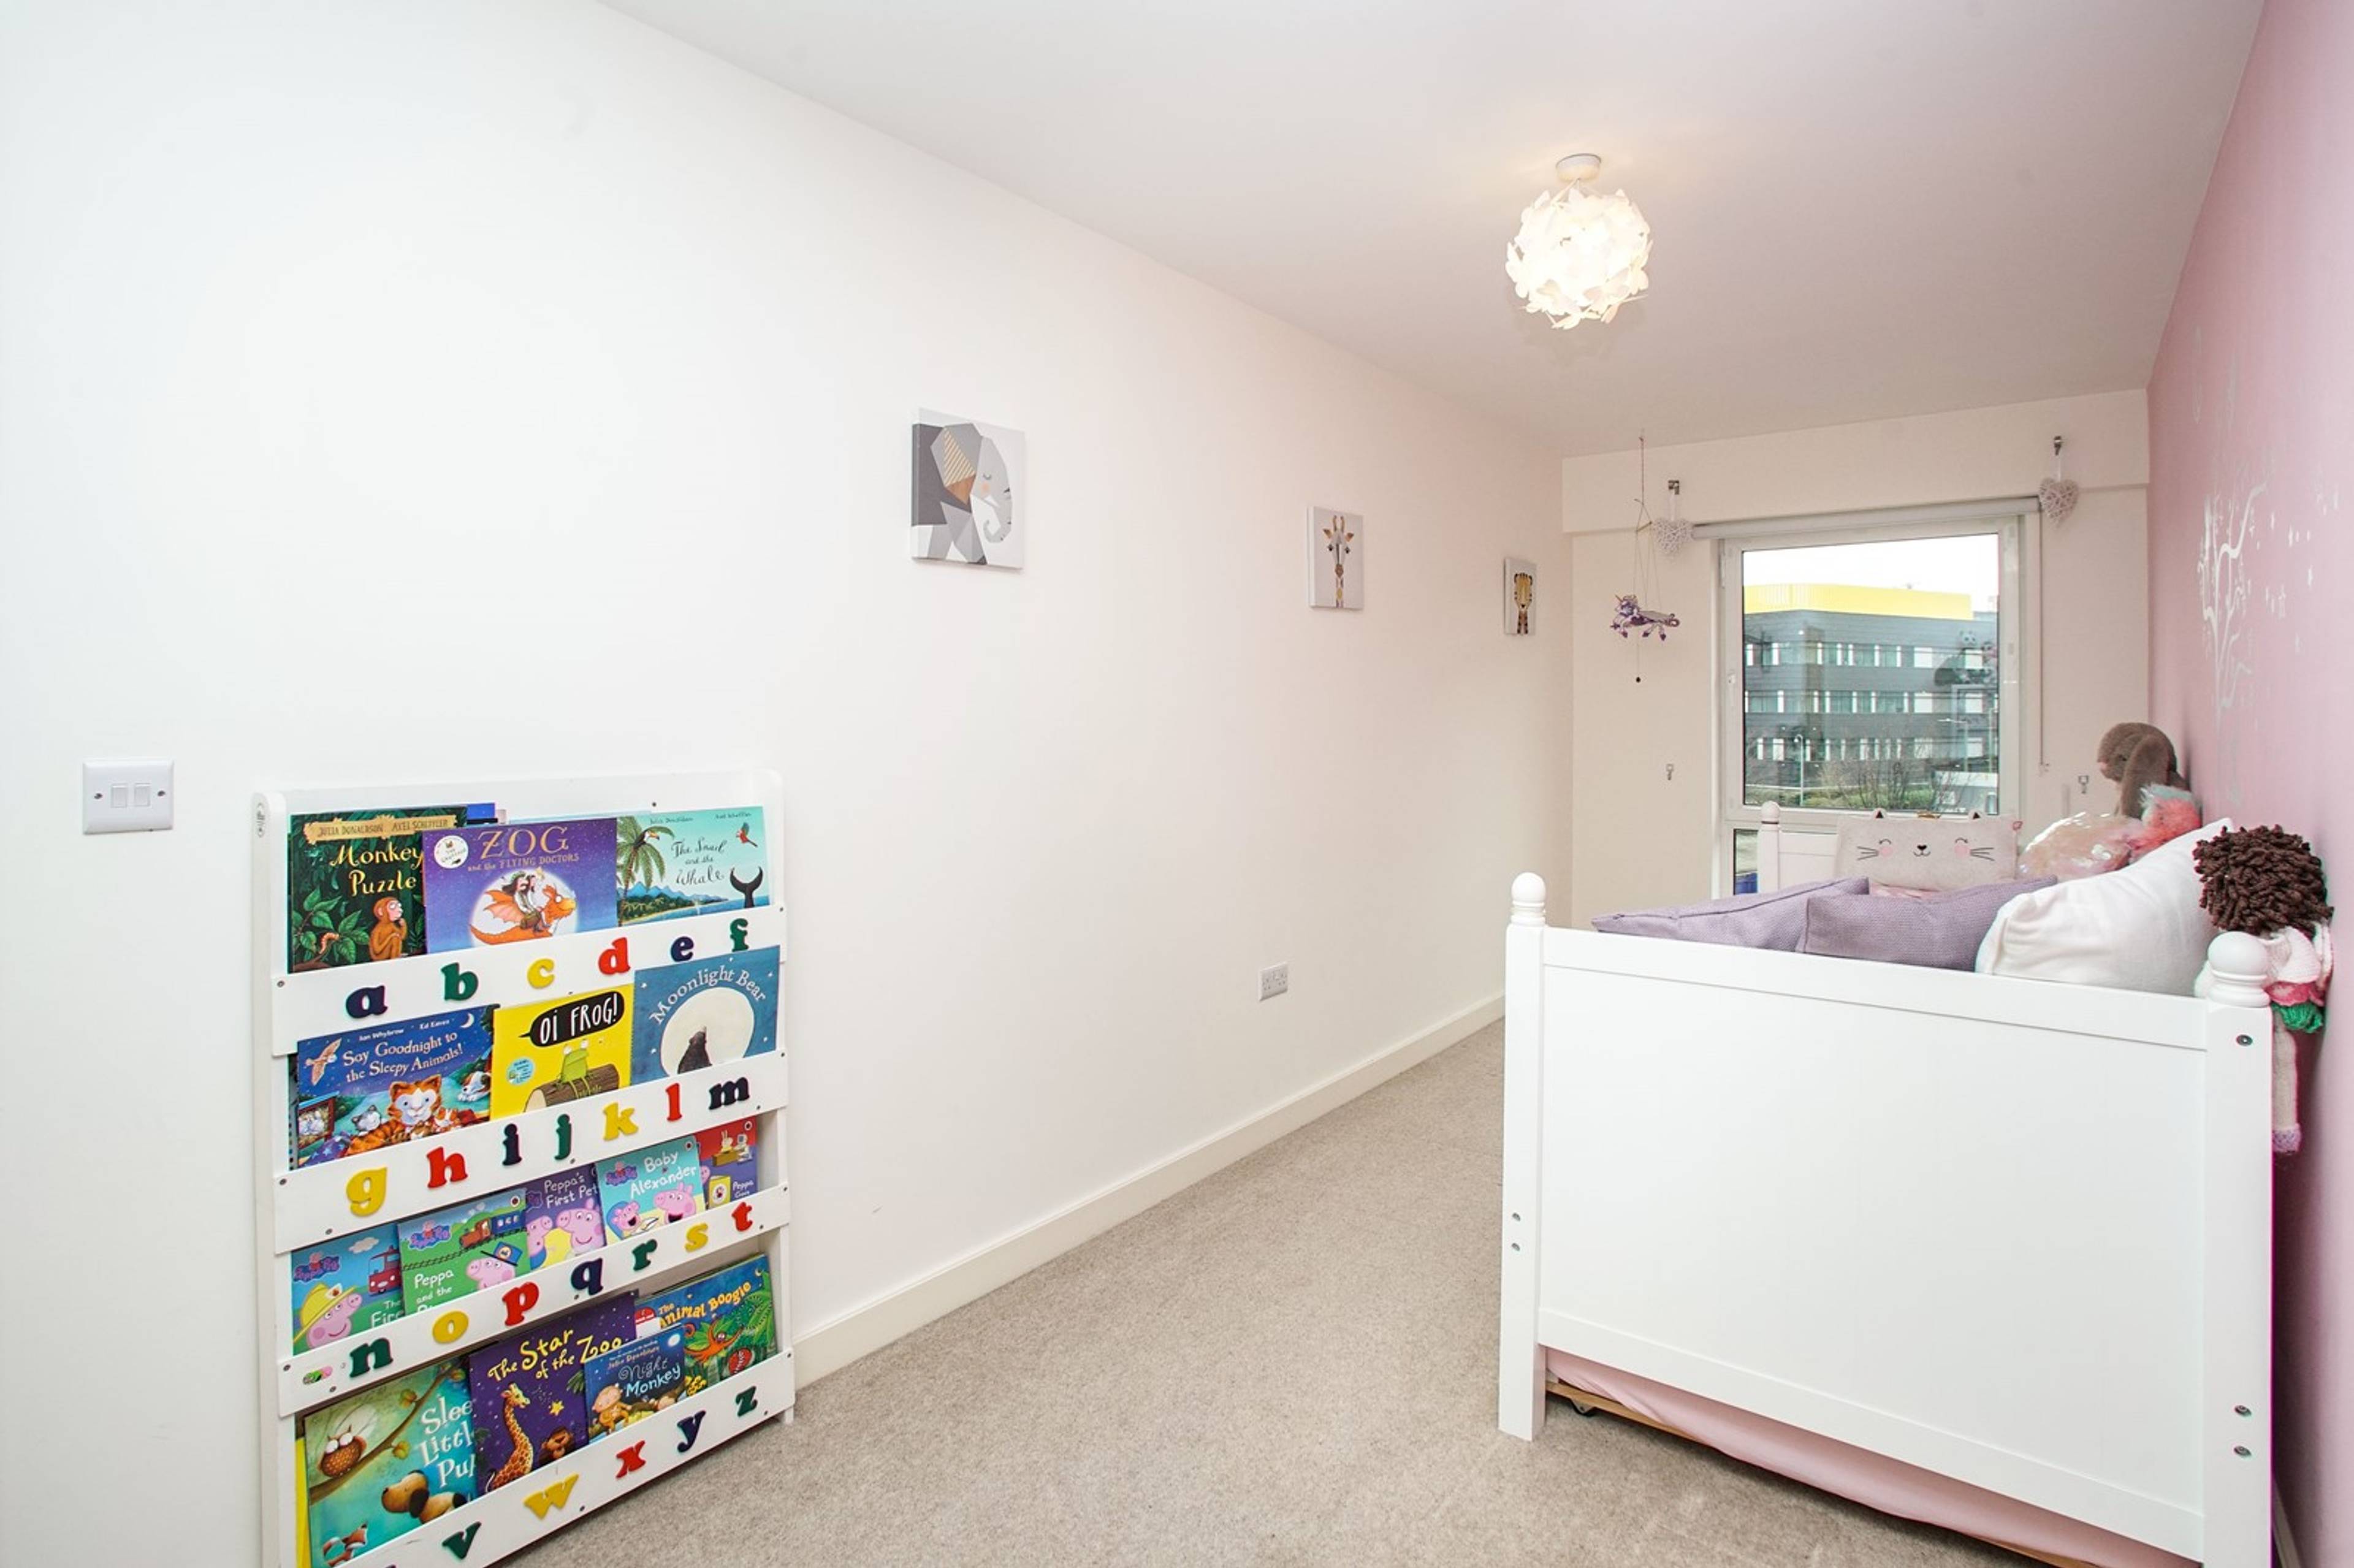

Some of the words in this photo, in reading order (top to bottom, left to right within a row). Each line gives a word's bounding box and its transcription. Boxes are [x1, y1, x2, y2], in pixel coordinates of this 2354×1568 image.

[329, 841, 424, 870] Monkey
[478, 826, 569, 859] ZOG
[671, 839, 692, 858] The
[695, 836, 728, 854] Snail
[500, 857, 536, 869] FLYING
[539, 853, 579, 865] DOCTORS
[676, 864, 725, 885] Whale
[348, 869, 417, 897] Puzzle
[345, 985, 387, 1019] a
[441, 962, 478, 1001] b
[526, 957, 555, 988] c
[598, 937, 631, 976] d
[671, 936, 694, 962] e
[729, 918, 749, 953] f
[648, 965, 735, 1026] Moonlight
[736, 969, 766, 1002] Bear
[570, 992, 618, 1037] FROG!
[342, 1050, 369, 1067] Say
[375, 1036, 442, 1057] Goodnight
[444, 1032, 457, 1043] to
[346, 1068, 366, 1083] the
[369, 1060, 410, 1076] Sleepy
[411, 1042, 463, 1071] Animals!
[345, 1166, 389, 1217] g
[426, 1146, 468, 1190] h
[501, 1124, 522, 1166] i
[554, 1113, 572, 1160] j
[603, 1101, 639, 1141] k
[666, 1083, 683, 1122] l
[709, 1076, 750, 1110] m
[644, 1151, 679, 1173] Baby
[544, 1172, 585, 1194] Peppa's
[546, 1190, 576, 1209] First
[578, 1183, 598, 1199] Pet
[630, 1166, 697, 1200] Alexander
[349, 1337, 394, 1378] n
[431, 1309, 470, 1344] o
[501, 1281, 540, 1327] p
[570, 1257, 604, 1296] q
[631, 1238, 658, 1271] r
[683, 1222, 709, 1252] s
[731, 1201, 753, 1232] t
[414, 1269, 454, 1289] Peppa
[416, 1293, 433, 1304] and
[436, 1287, 453, 1296] the
[487, 1357, 518, 1382] The
[520, 1328, 574, 1371] Star
[535, 1359, 549, 1380] of
[552, 1349, 575, 1371] the
[576, 1334, 623, 1364] Zoo
[618, 1355, 668, 1382] Night
[625, 1362, 681, 1398] Monkey
[441, 1521, 482, 1560] v
[522, 1472, 579, 1520] w
[616, 1439, 647, 1478] x
[677, 1410, 706, 1453] y
[735, 1386, 758, 1417] z
